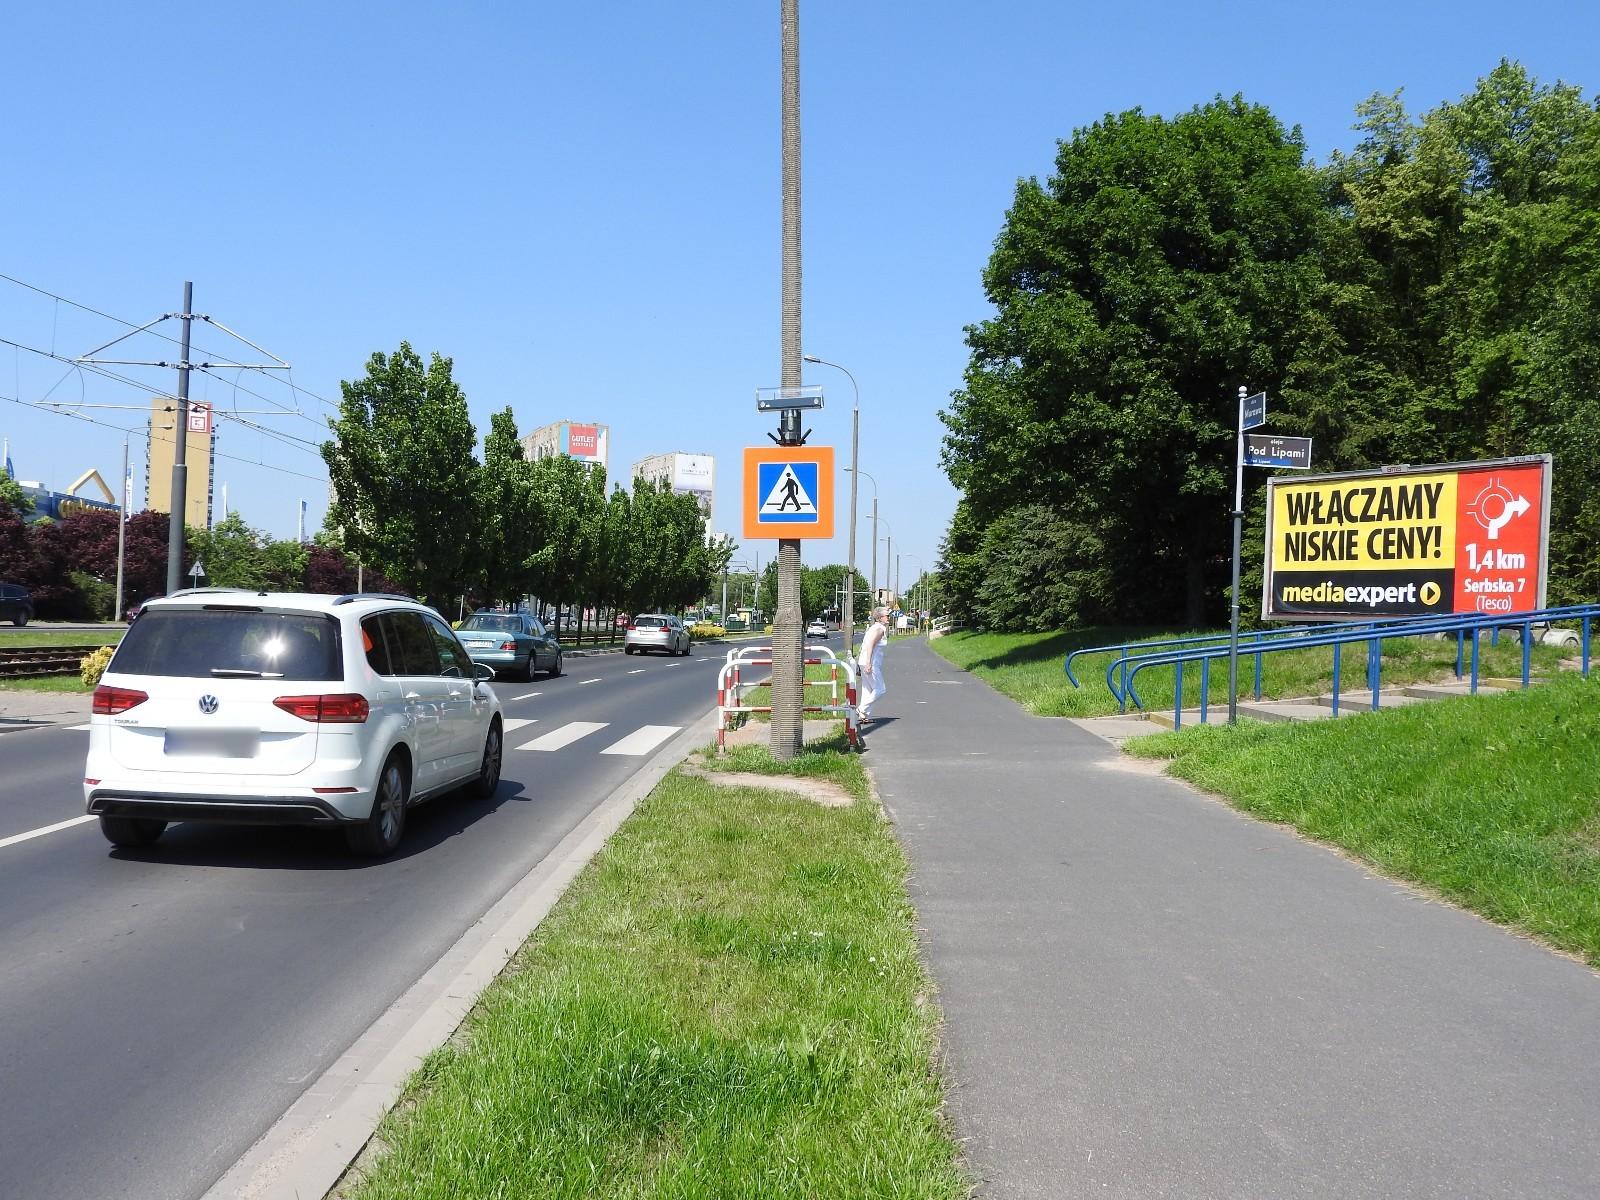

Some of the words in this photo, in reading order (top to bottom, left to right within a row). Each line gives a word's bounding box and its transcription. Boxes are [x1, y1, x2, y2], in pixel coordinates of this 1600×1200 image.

[1248, 446, 1266, 455] Pod
[1272, 447, 1304, 459] Lipami
[1286, 483, 1444, 527] WŁĄCZAMY
[1284, 528, 1358, 562] NISKIE
[1367, 526, 1442, 560] CENY!
[1465, 544, 1494, 573] 1,4
[1497, 547, 1525, 570] km
[1282, 581, 1416, 607] mediaexpert
[1464, 578, 1515, 594] Serbska
[1517, 580, 1525, 593] 7
[1476, 595, 1512, 611] (Tesco)
